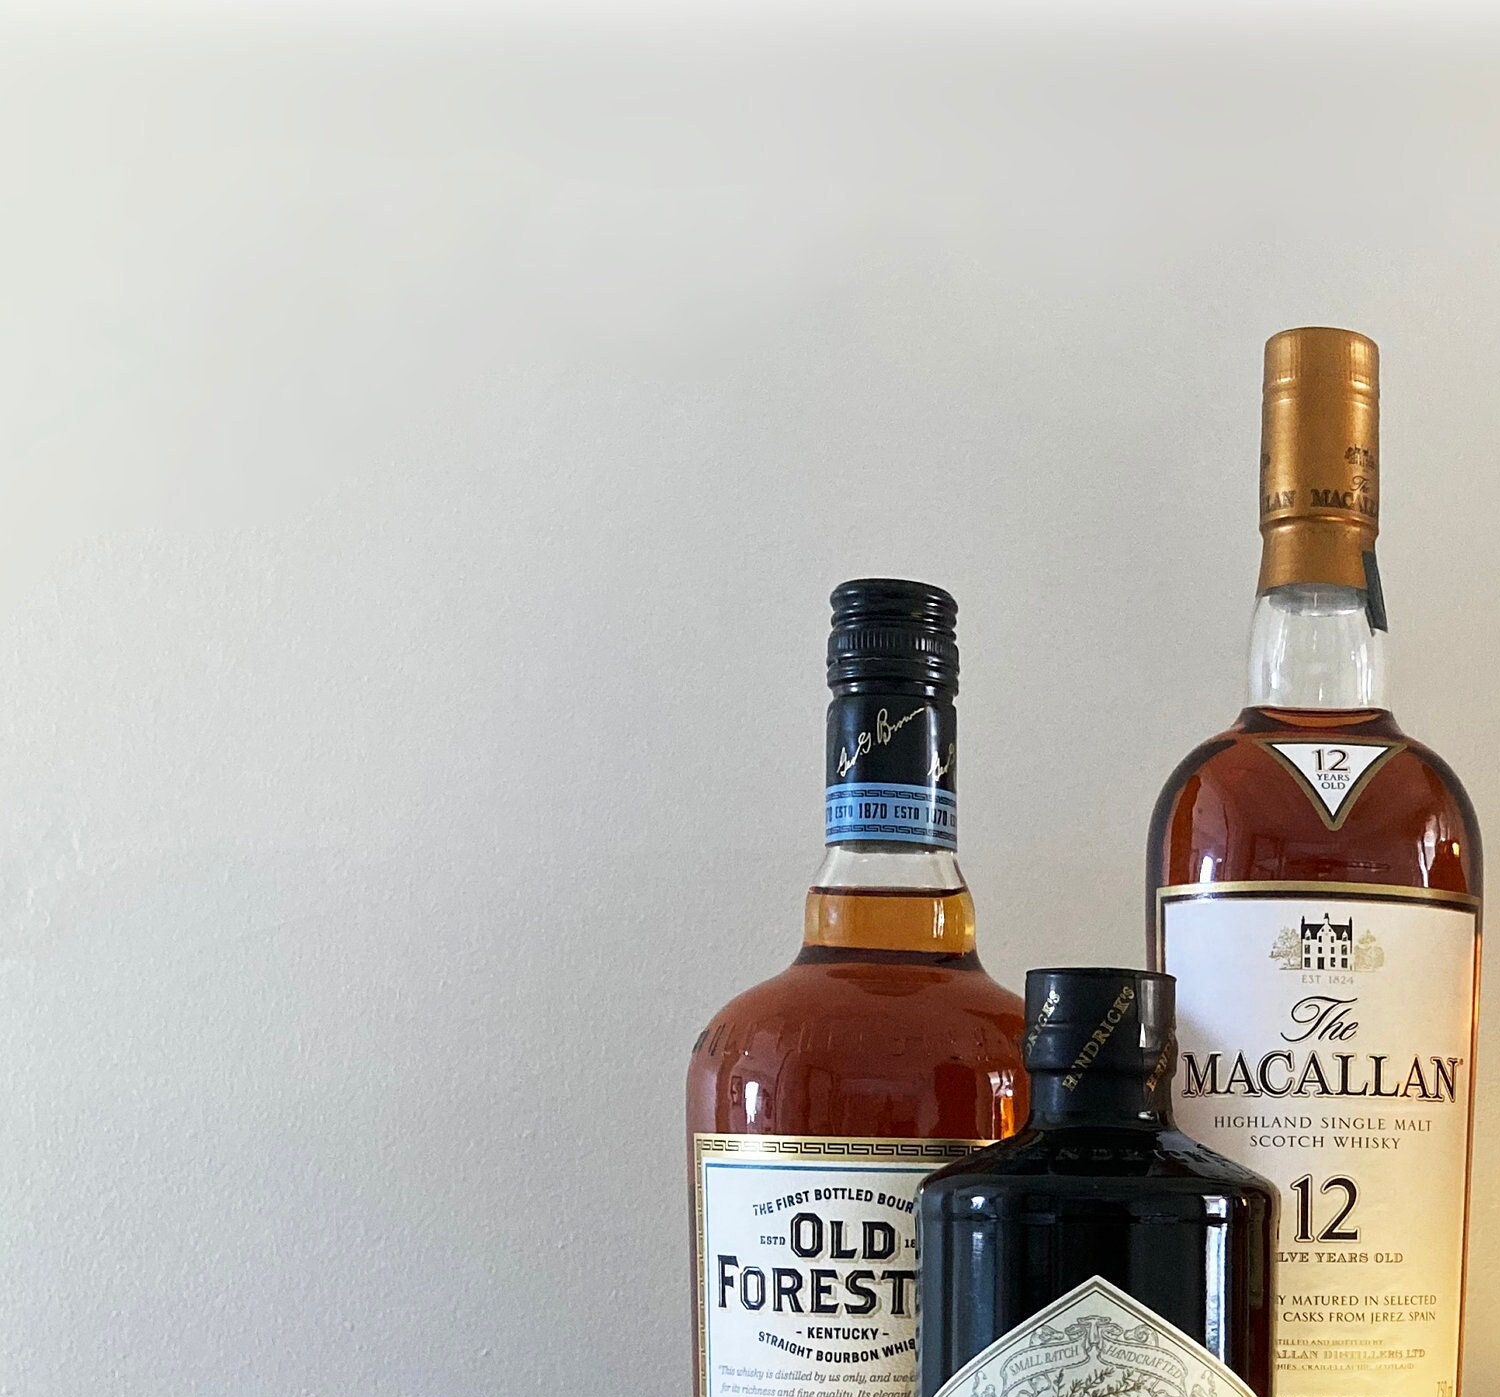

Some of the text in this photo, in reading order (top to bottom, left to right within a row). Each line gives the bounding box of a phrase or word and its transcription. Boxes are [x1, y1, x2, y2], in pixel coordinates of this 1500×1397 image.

[1312, 748, 1350, 773] 12
[1316, 773, 1350, 782] YEARS
[1321, 782, 1346, 790] OLD
[859, 803, 887, 819] 1870
[1280, 995, 1360, 1042] The
[1182, 1050, 1460, 1103] MACALLAN
[1214, 1116, 1433, 1132] HIGHLAND SINGLE MALT
[1250, 1135, 1401, 1150] SCOTCH WHISKY
[753, 1188, 914, 1216] THE FIRST BOTTLED BOUR
[1290, 1174, 1361, 1243] 12
[760, 1212, 897, 1261] ESTD OLD
[1315, 1252, 1404, 1263] YEARS OLD
[717, 1254, 916, 1316] FOREST
[1292, 1295, 1437, 1306] MATURED IN SELECTED
[1283, 1312, 1324, 1323] CASKS
[1329, 1312, 1365, 1322] FROM
[1409, 1312, 1436, 1322] SPAIN
[807, 1327, 879, 1341] KENTUCKY
[758, 1331, 879, 1363] STRAIGHT BOURBON
[1009, 1345, 1080, 1376] SMALL BATCH
[1105, 1344, 1182, 1379] HANDCRAFTED
[775, 1369, 812, 1381] distilled
[814, 1371, 826, 1383] by
[828, 1374, 840, 1382] us
[842, 1372, 867, 1384] only,
[870, 1372, 890, 1383] and
[777, 1388, 794, 1397] and
